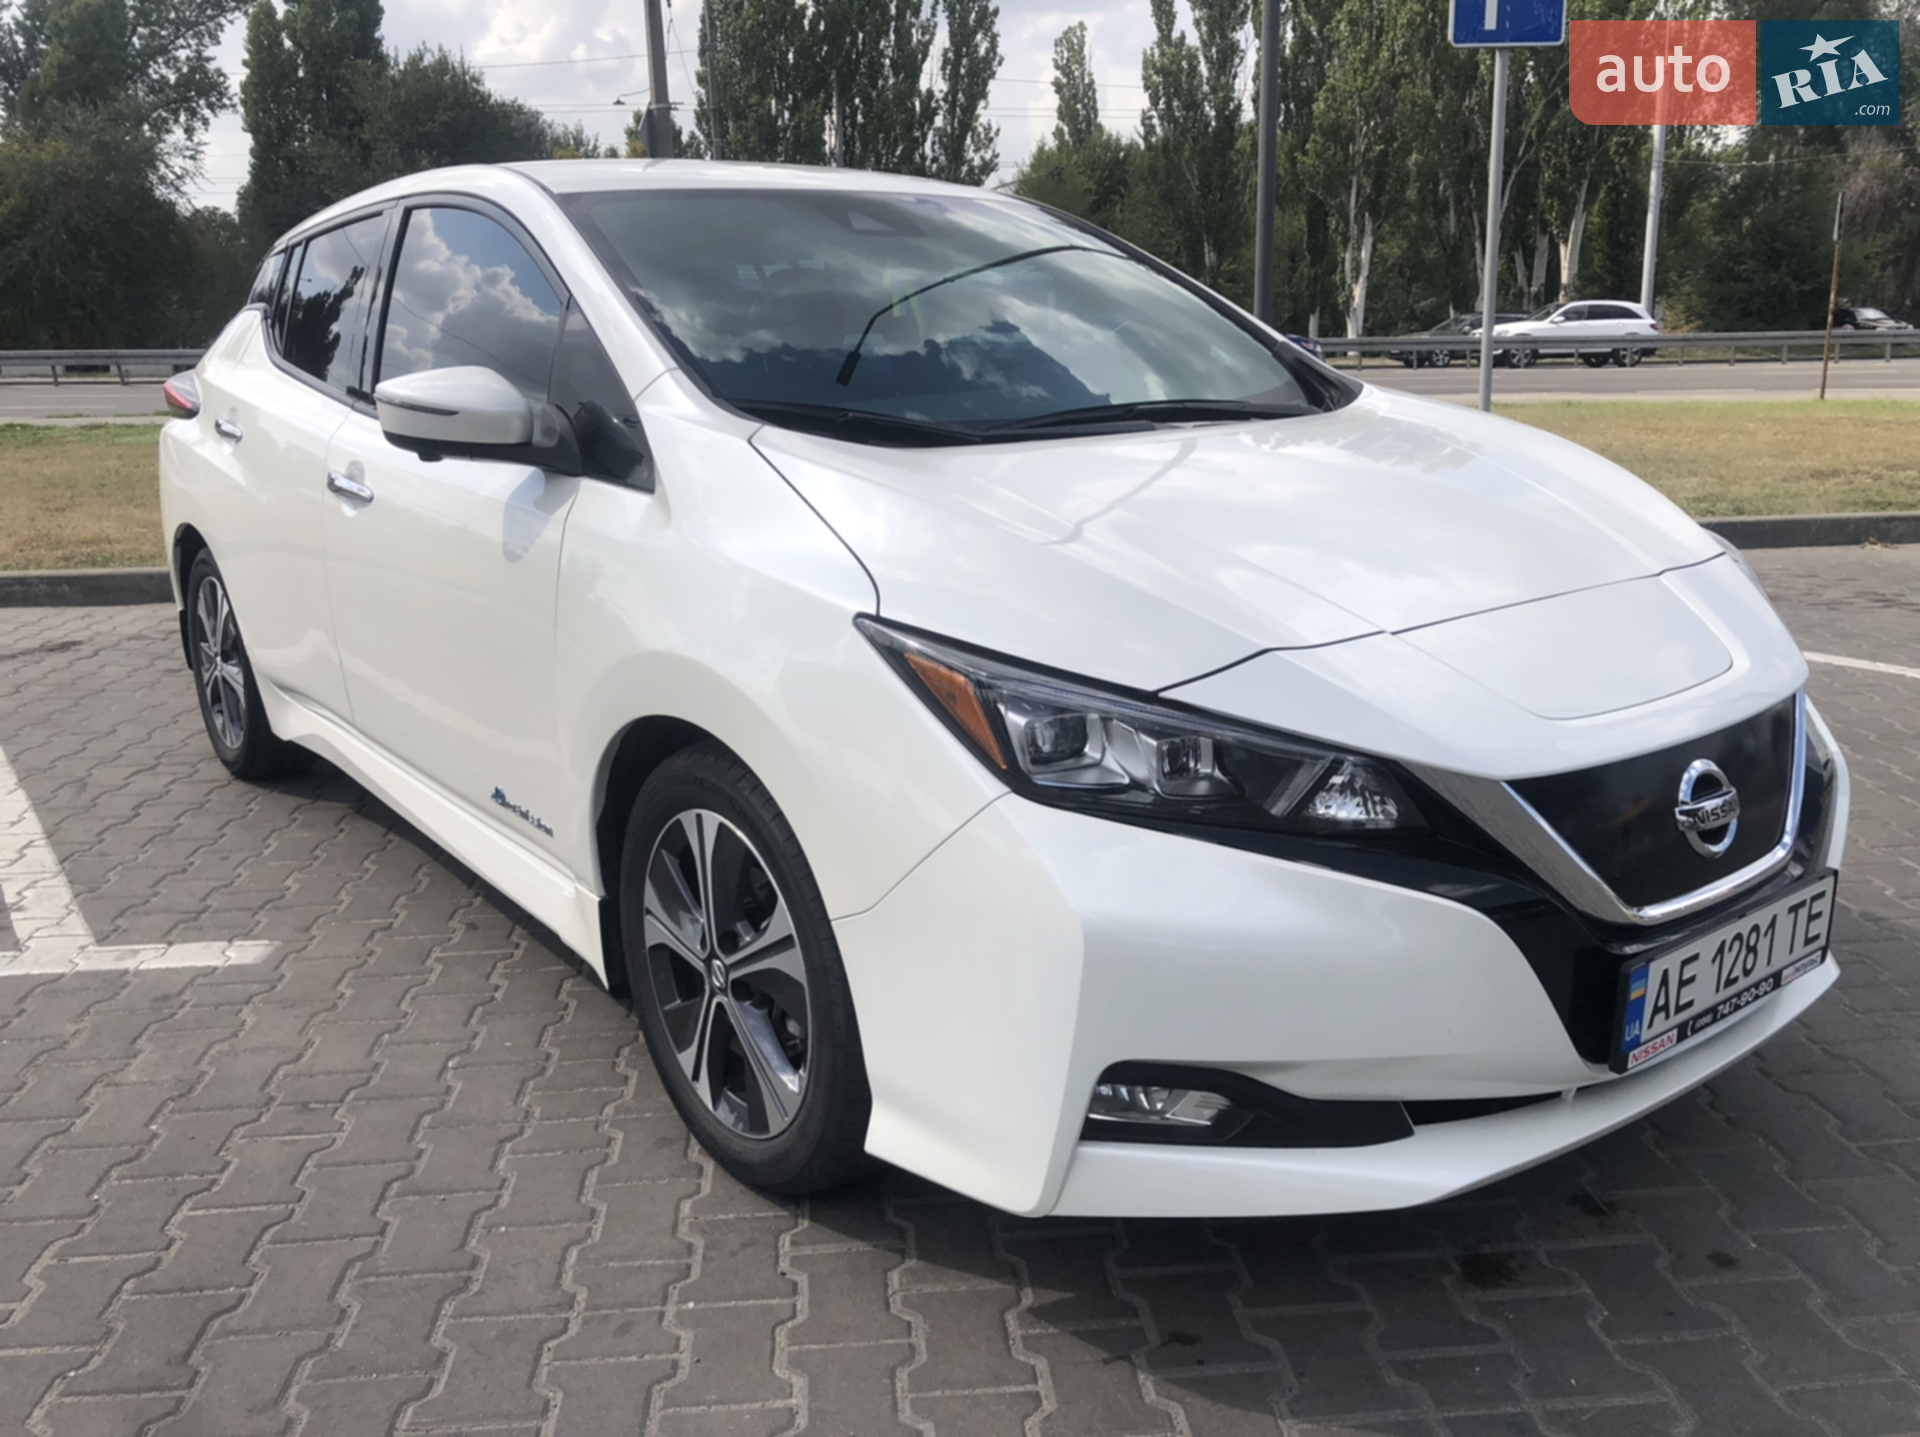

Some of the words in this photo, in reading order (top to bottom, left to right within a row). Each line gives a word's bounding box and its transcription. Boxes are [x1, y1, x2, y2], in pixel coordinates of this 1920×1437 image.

[1647, 952, 1701, 1031] AE
[1711, 913, 1778, 995] 1281
[1787, 889, 1827, 956] TE
[1624, 1020, 1642, 1042] UA
[1630, 1031, 1677, 1065] NISSAN
